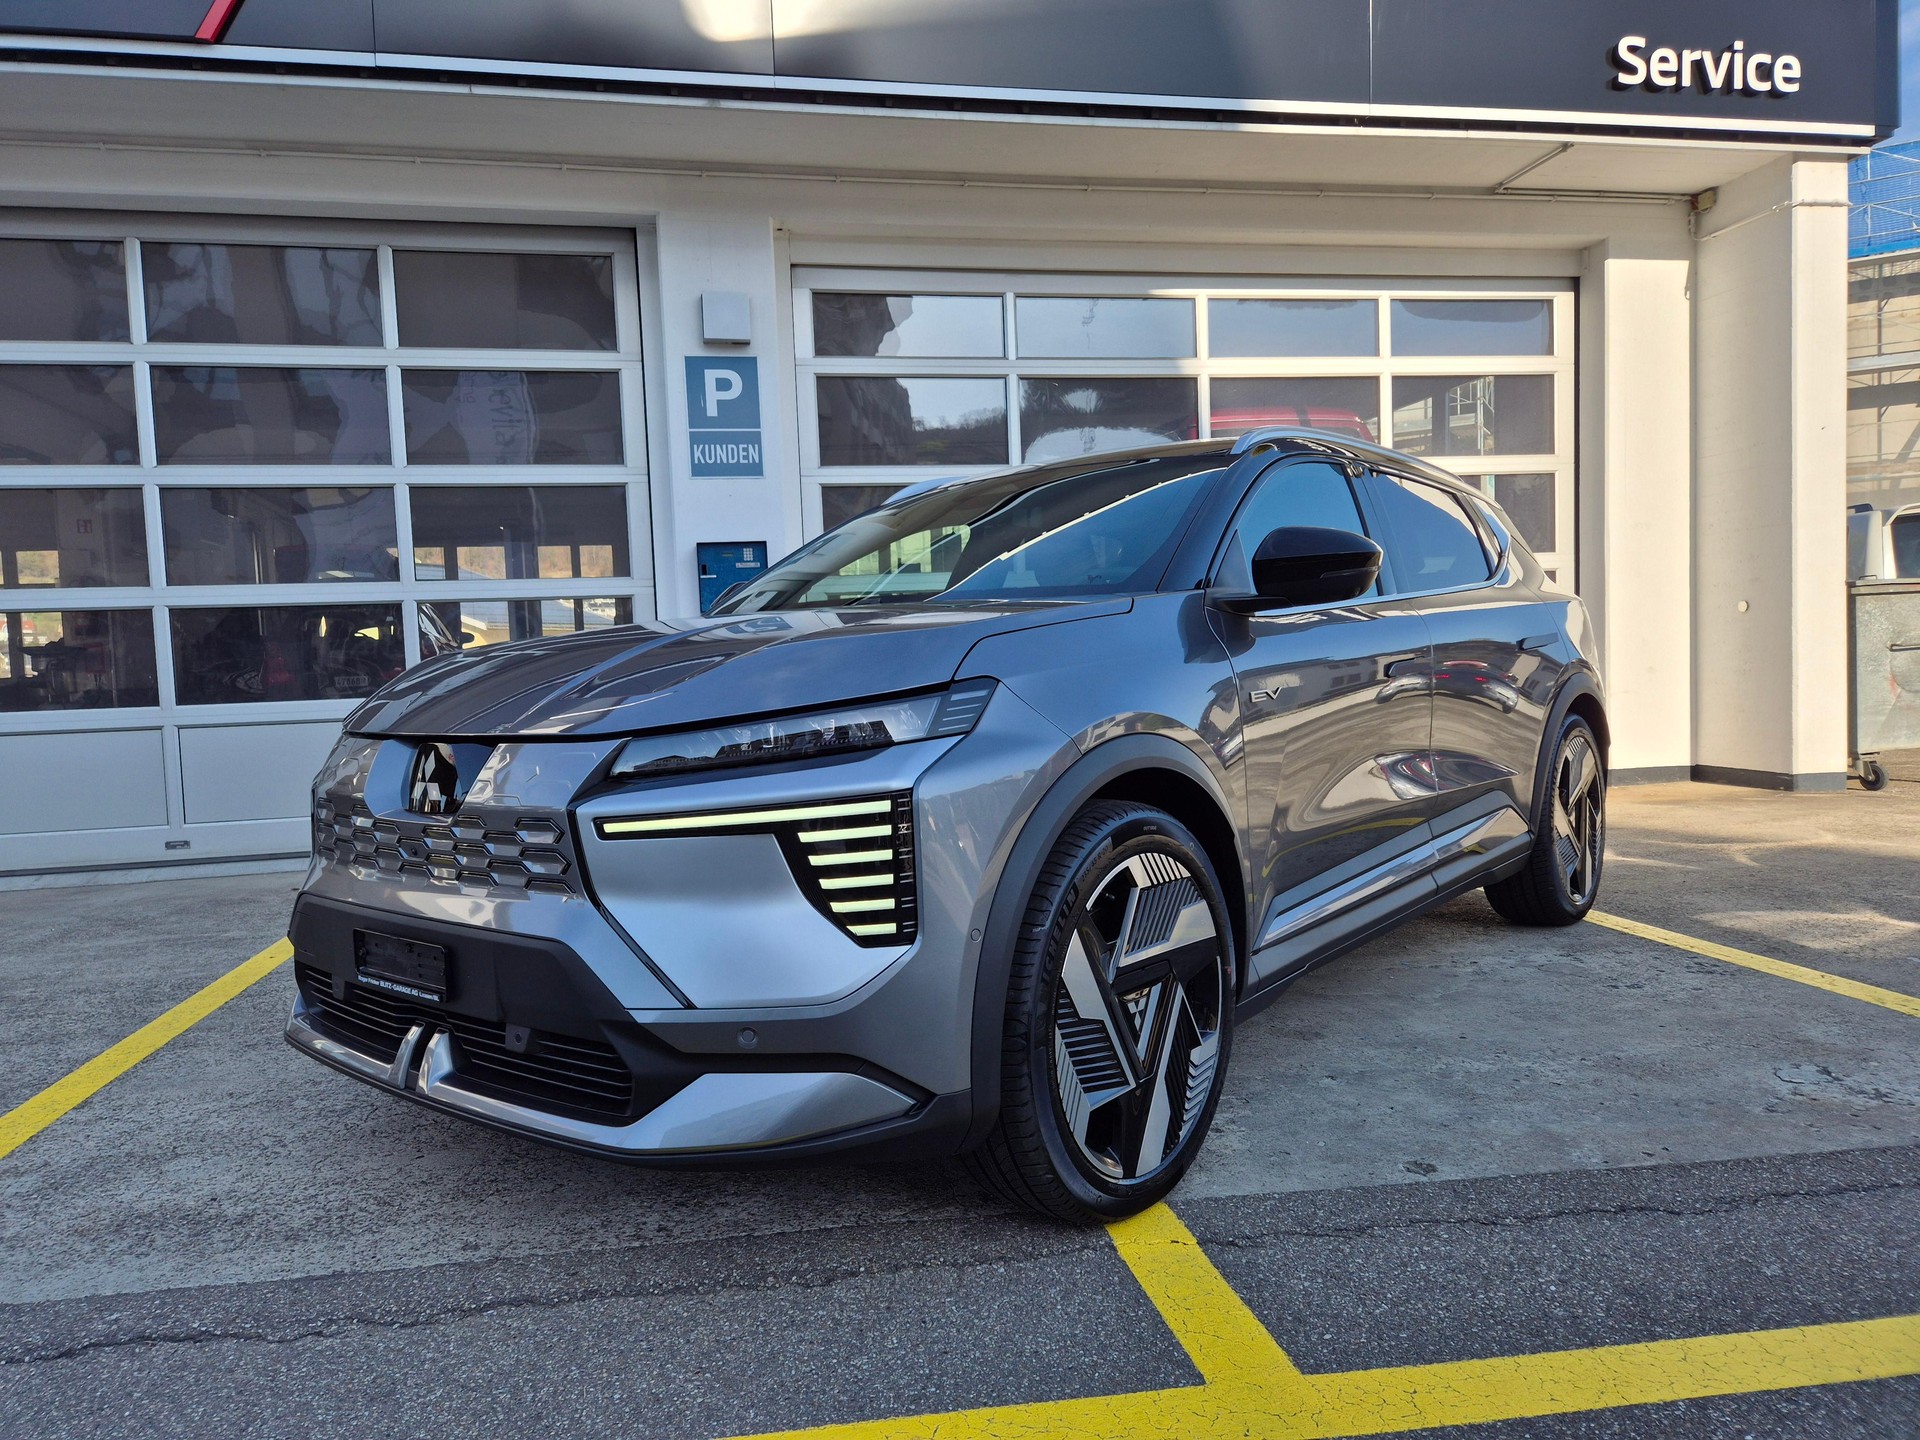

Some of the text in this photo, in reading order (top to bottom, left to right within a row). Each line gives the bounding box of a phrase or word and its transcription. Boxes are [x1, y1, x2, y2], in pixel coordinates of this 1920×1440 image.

[1615, 35, 1802, 93] Service
[704, 368, 743, 417] P
[693, 444, 760, 464] KUNDEN
[1248, 687, 1282, 703] EV
